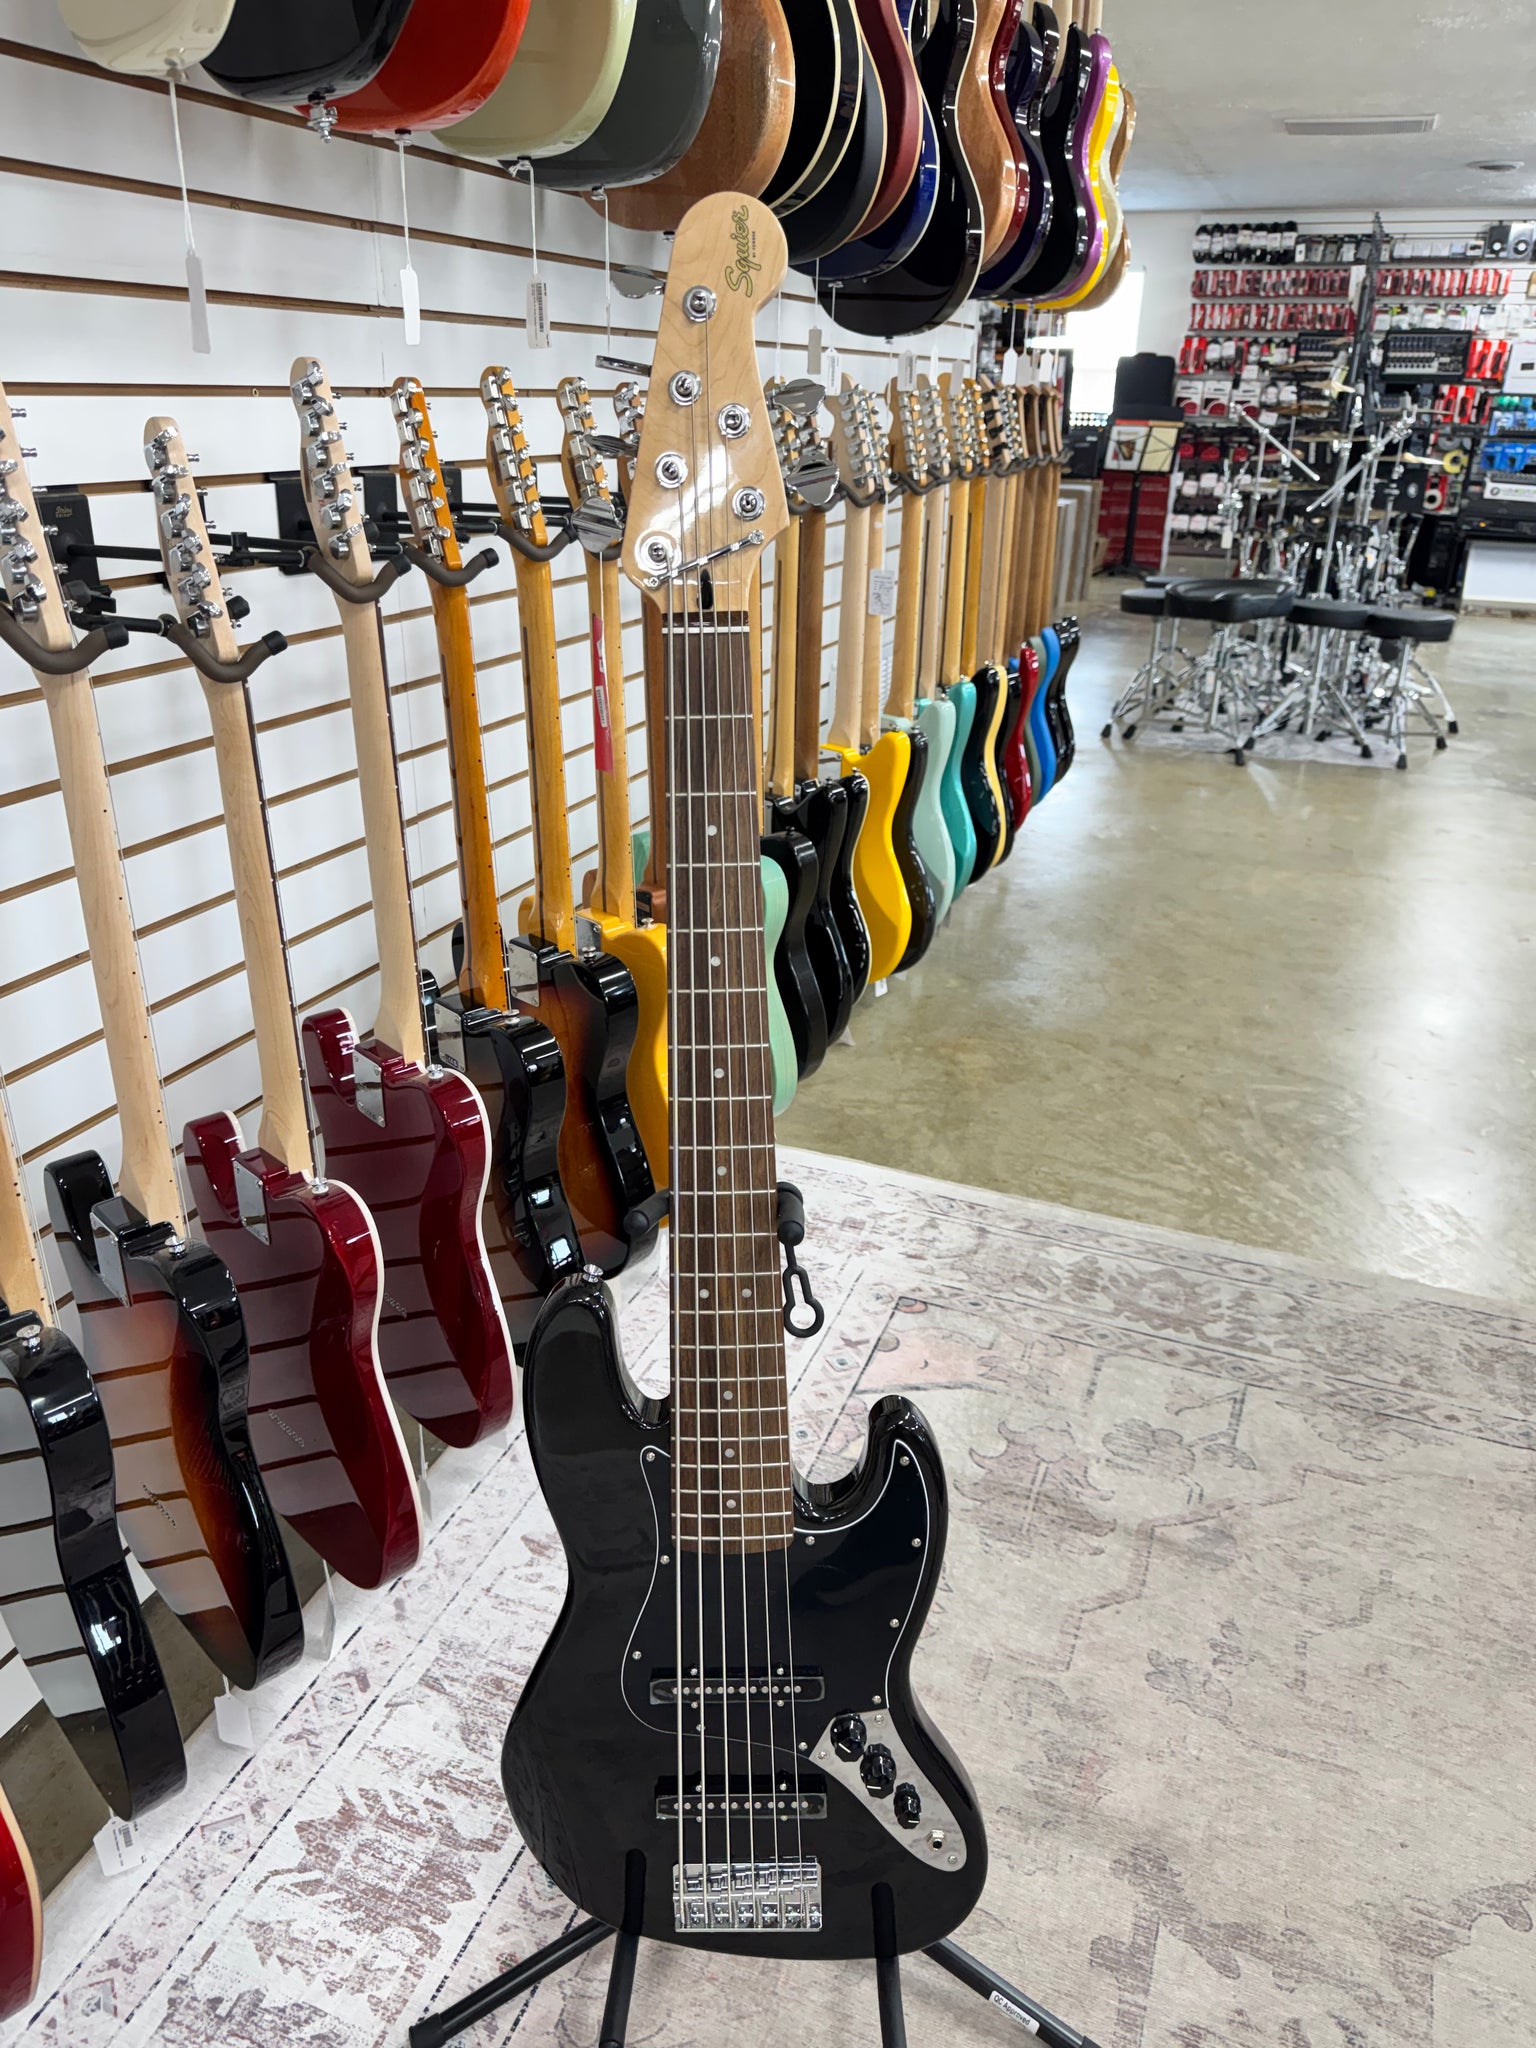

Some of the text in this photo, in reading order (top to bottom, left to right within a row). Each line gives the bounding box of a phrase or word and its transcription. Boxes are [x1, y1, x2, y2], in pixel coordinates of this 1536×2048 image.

[725, 204, 762, 297] Squier
[993, 1994, 1030, 2026] QC Approved
